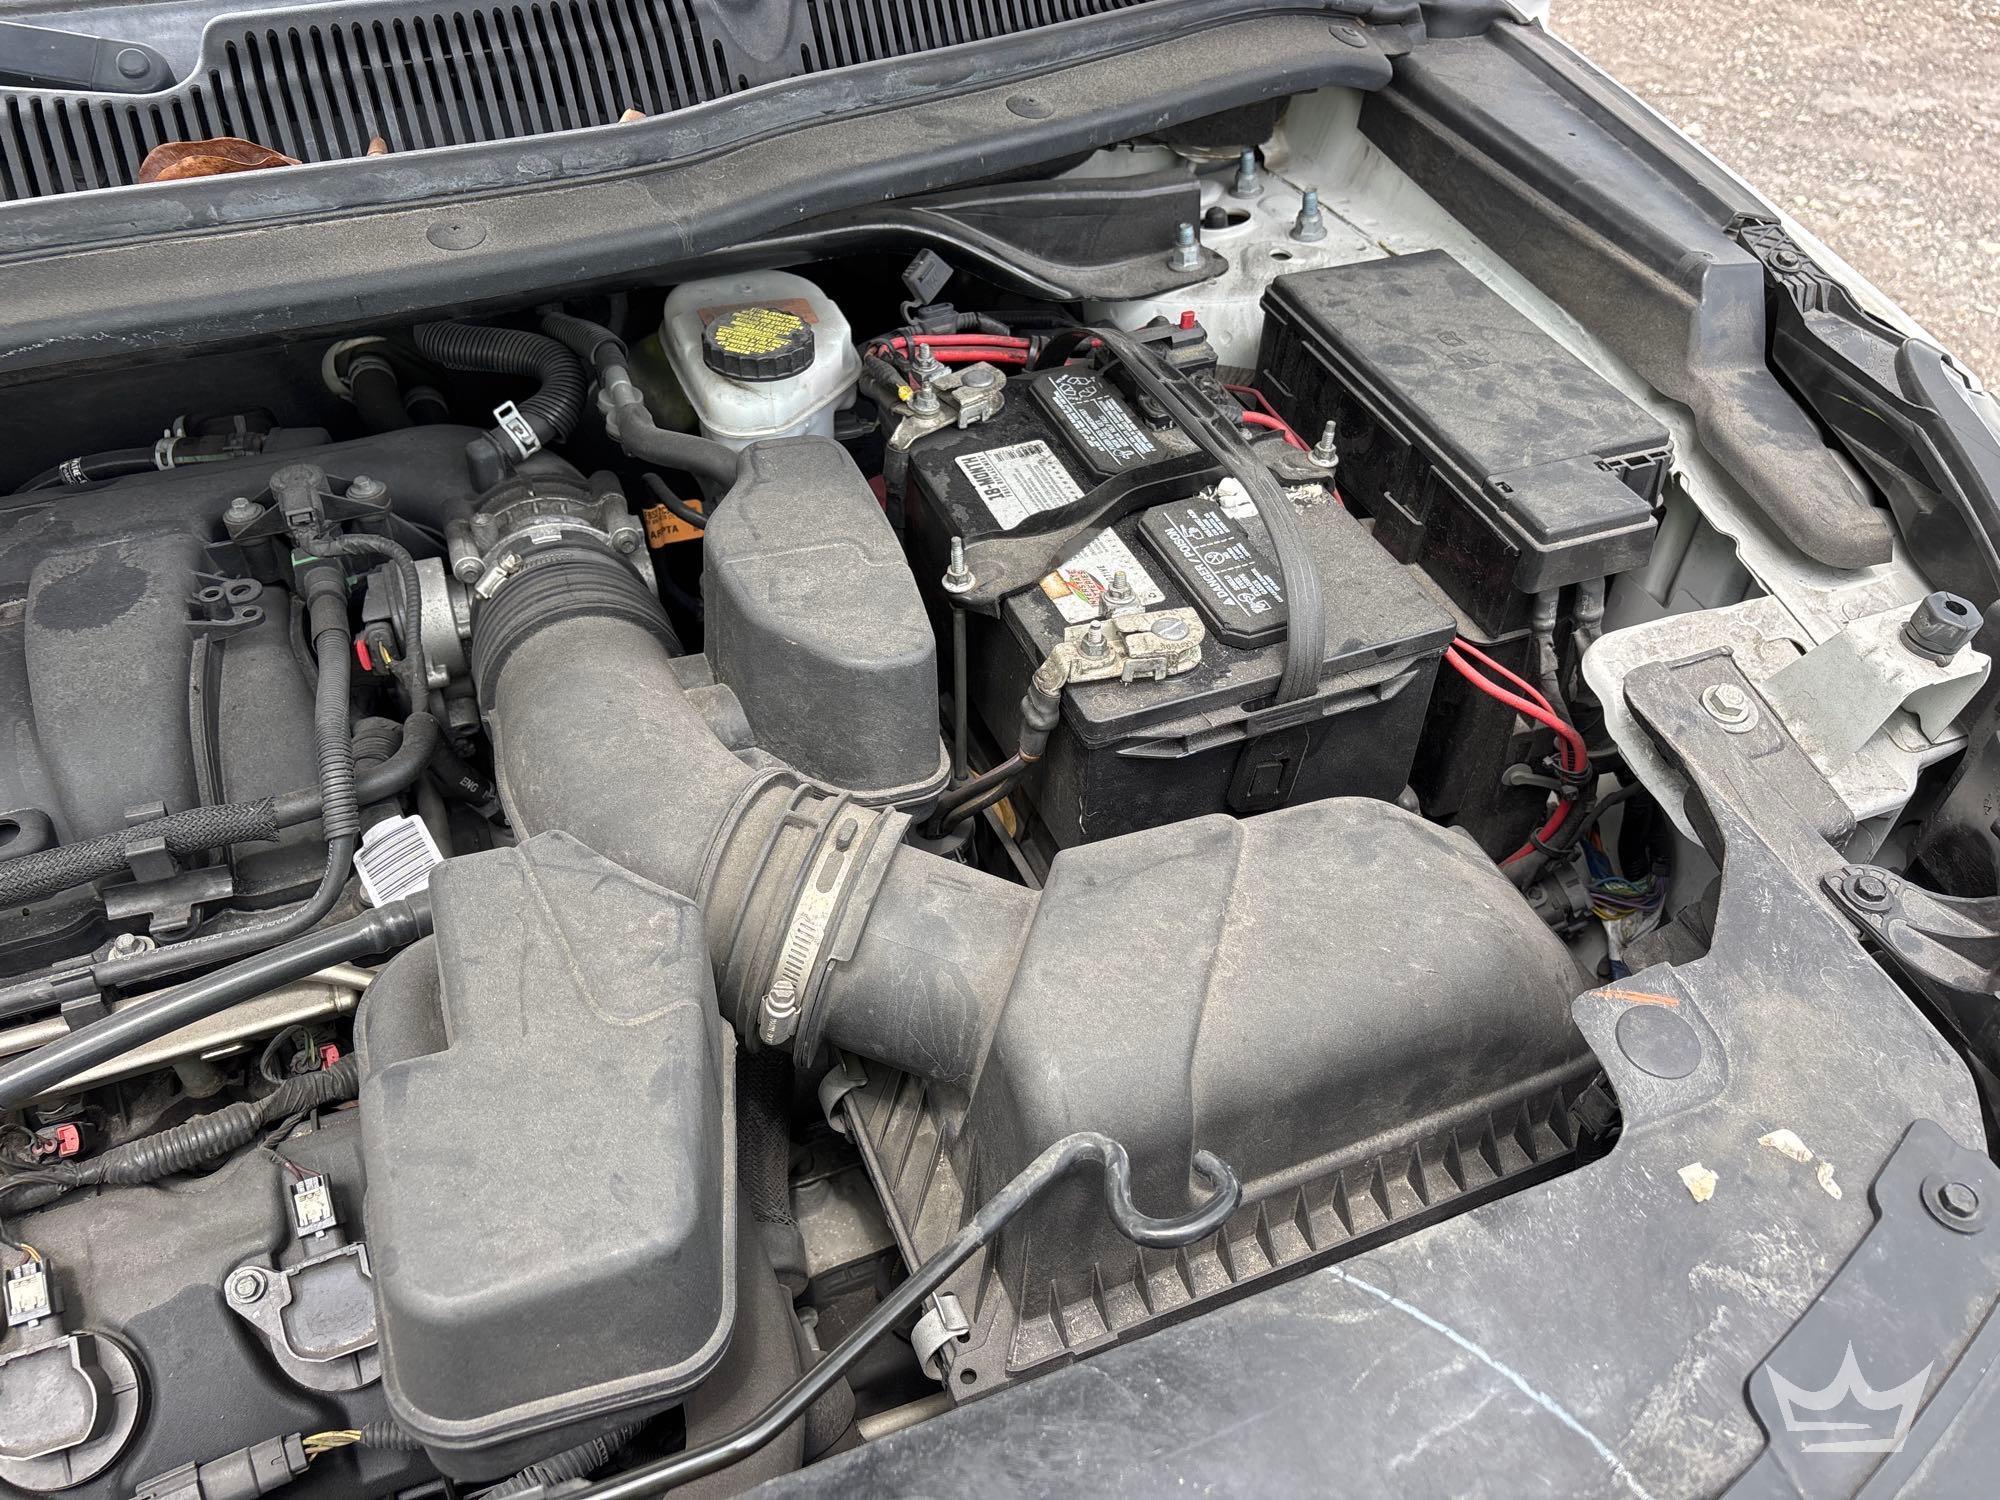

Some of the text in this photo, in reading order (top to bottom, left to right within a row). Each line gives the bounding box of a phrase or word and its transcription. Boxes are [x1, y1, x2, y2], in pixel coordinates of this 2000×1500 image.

[961, 456, 1004, 500] 18-MONTH
[1164, 527, 1196, 558] POISON
[1194, 563, 1229, 599] DANGER
